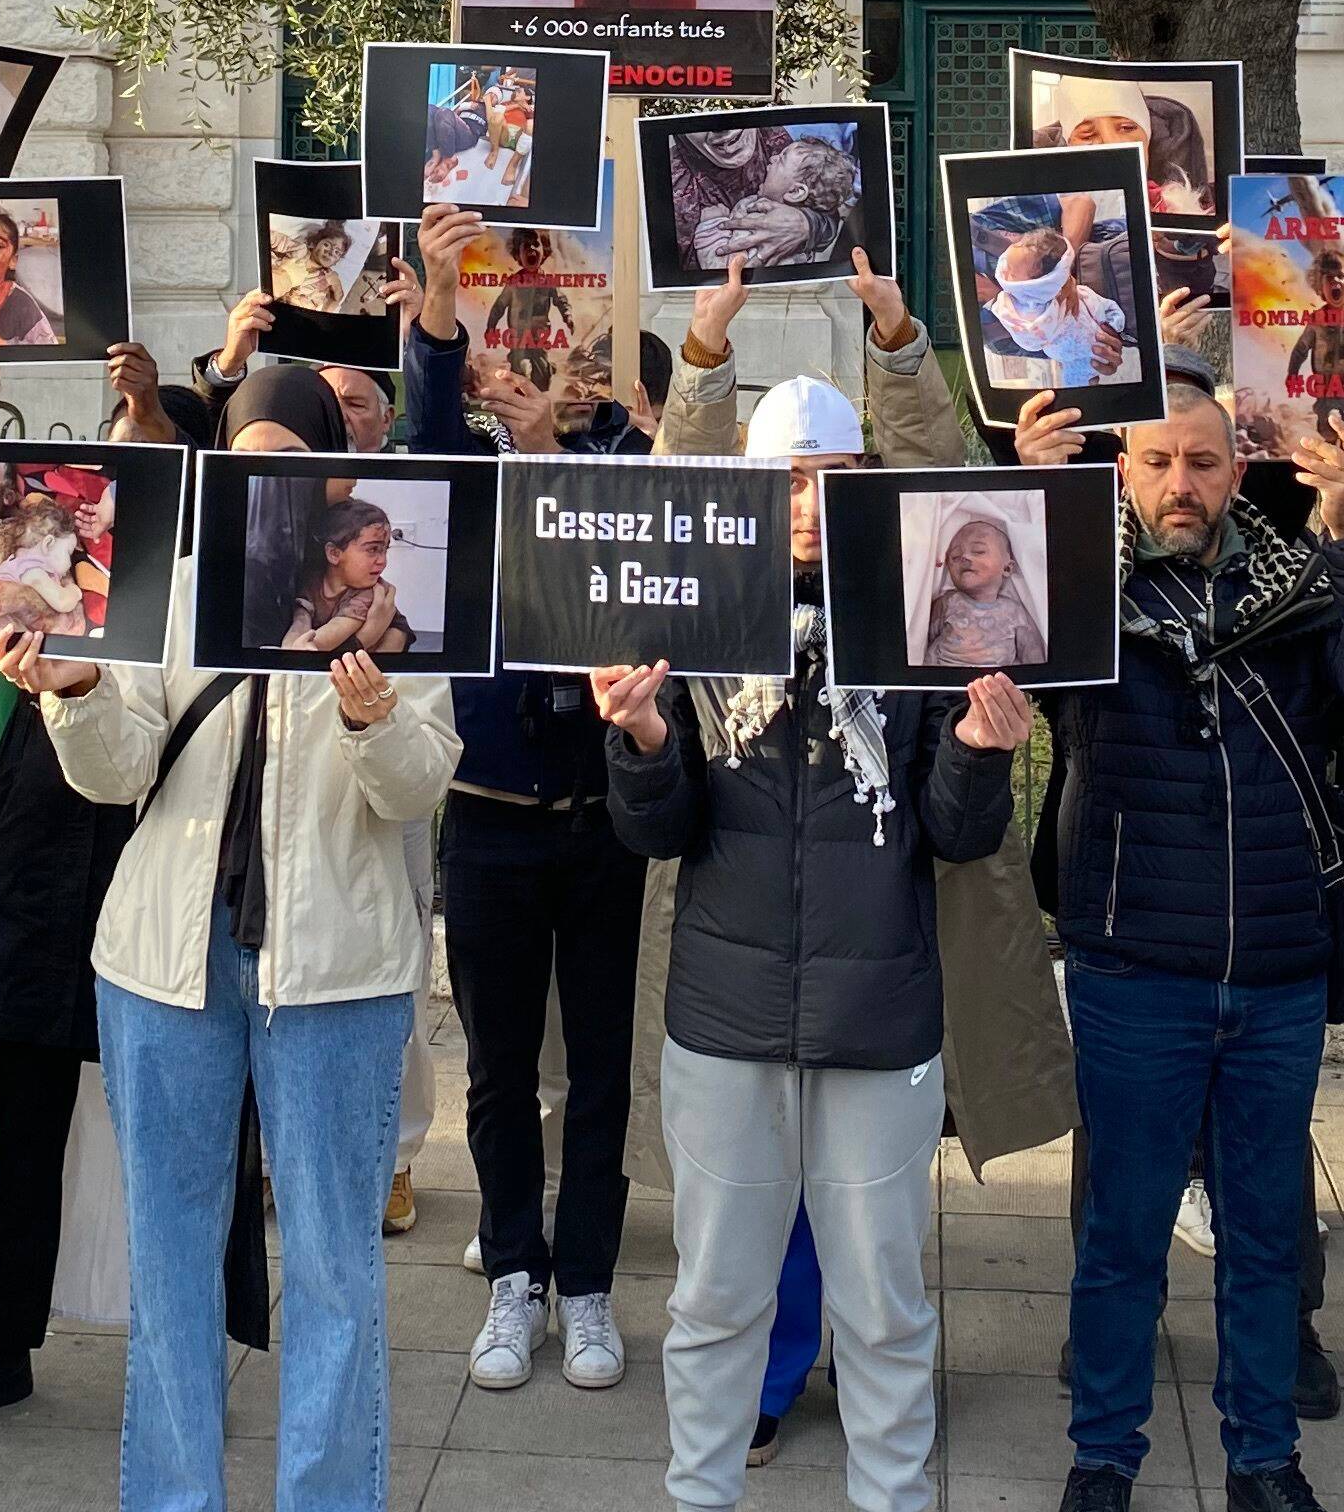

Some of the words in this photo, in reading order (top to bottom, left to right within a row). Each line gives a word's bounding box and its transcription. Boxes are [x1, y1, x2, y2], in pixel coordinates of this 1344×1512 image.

[510, 16, 538, 36] +6
[544, 20, 588, 37] 000
[593, 14, 673, 38] enfants
[679, 19, 725, 39] tués
[609, 65, 734, 87] ENOCIDE
[459, 273, 607, 289] OMBARDEMENTS
[484, 328, 570, 349] #GAZA
[536, 496, 653, 542] Cessez
[664, 500, 692, 543] le
[704, 502, 757, 546] feu
[589, 565, 608, 603] à
[620, 561, 699, 606] Gaza
